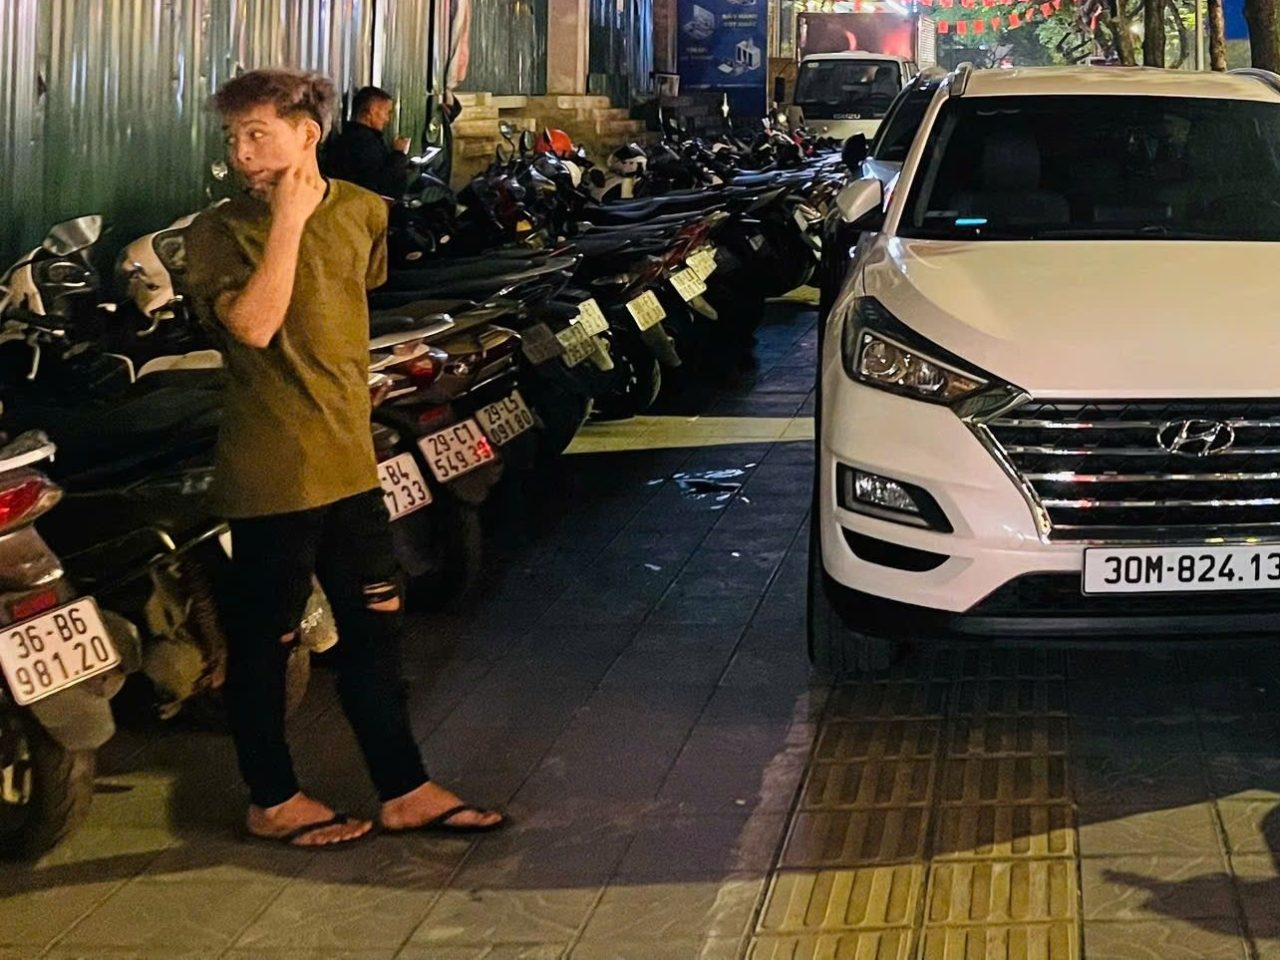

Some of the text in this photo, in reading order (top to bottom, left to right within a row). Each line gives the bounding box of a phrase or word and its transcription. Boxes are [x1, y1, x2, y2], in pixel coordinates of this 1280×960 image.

[429, 423, 475, 457] 29-C1
[490, 409, 531, 444] 091.80
[10, 607, 87, 659] 36-B6
[15, 635, 109, 695] 981.20
